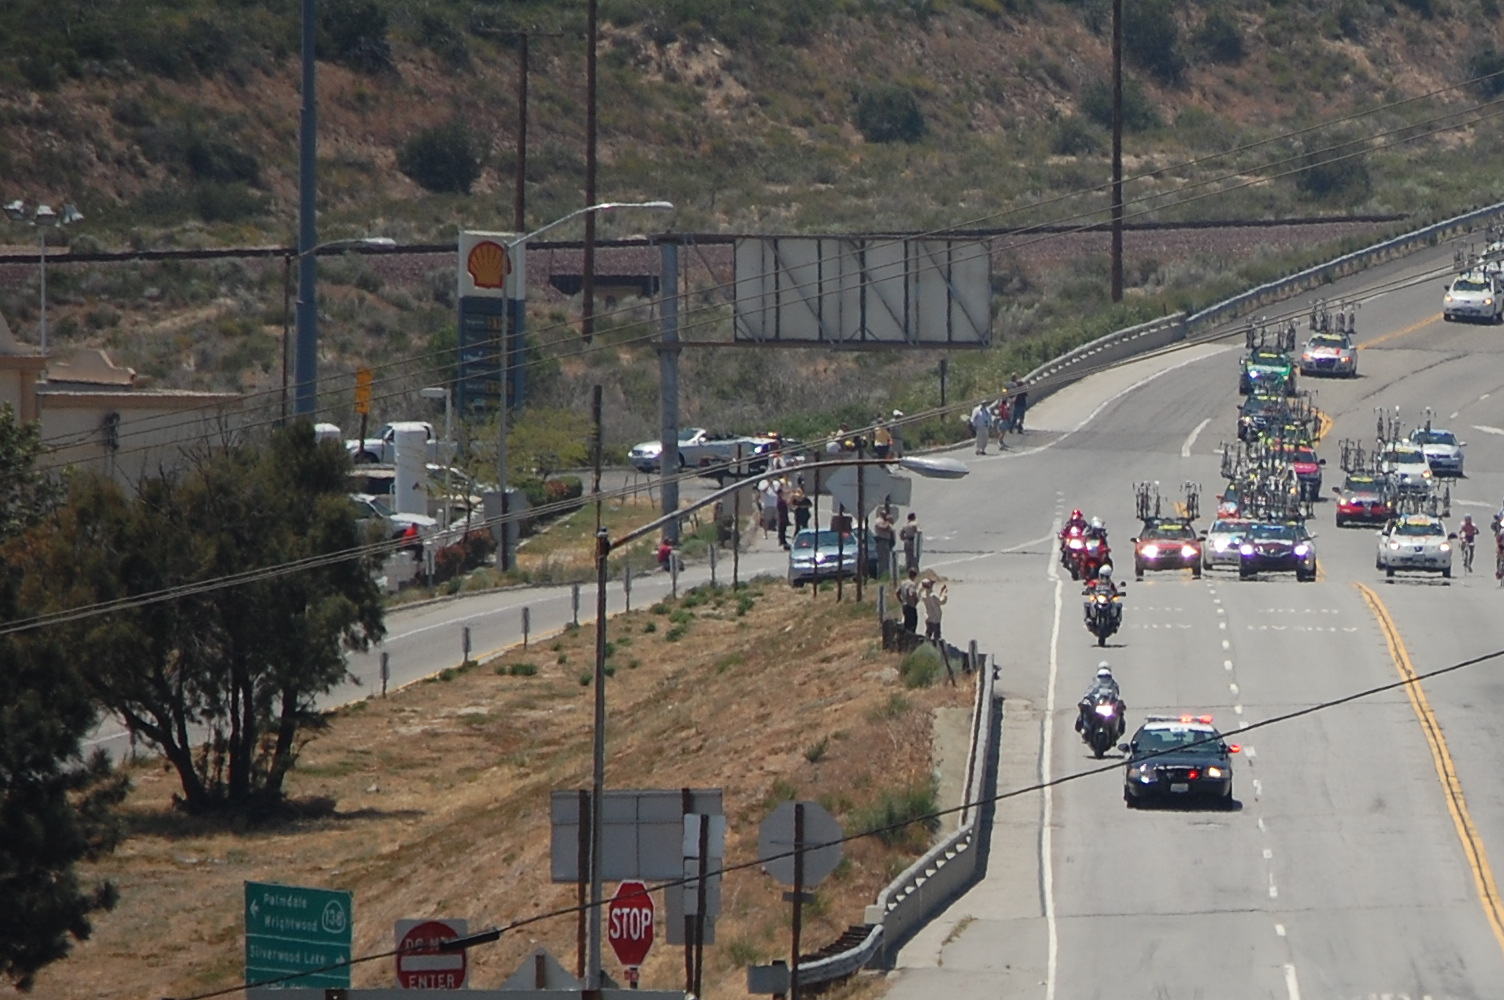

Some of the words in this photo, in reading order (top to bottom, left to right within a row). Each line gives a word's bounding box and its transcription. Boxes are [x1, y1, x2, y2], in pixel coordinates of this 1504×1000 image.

[263, 893, 308, 909] Palmdale
[264, 915, 318, 932] Wrightwood
[325, 908, 344, 928] 138
[610, 907, 652, 940] STOP
[304, 951, 326, 965] Lake
[408, 974, 456, 989] ENTER
